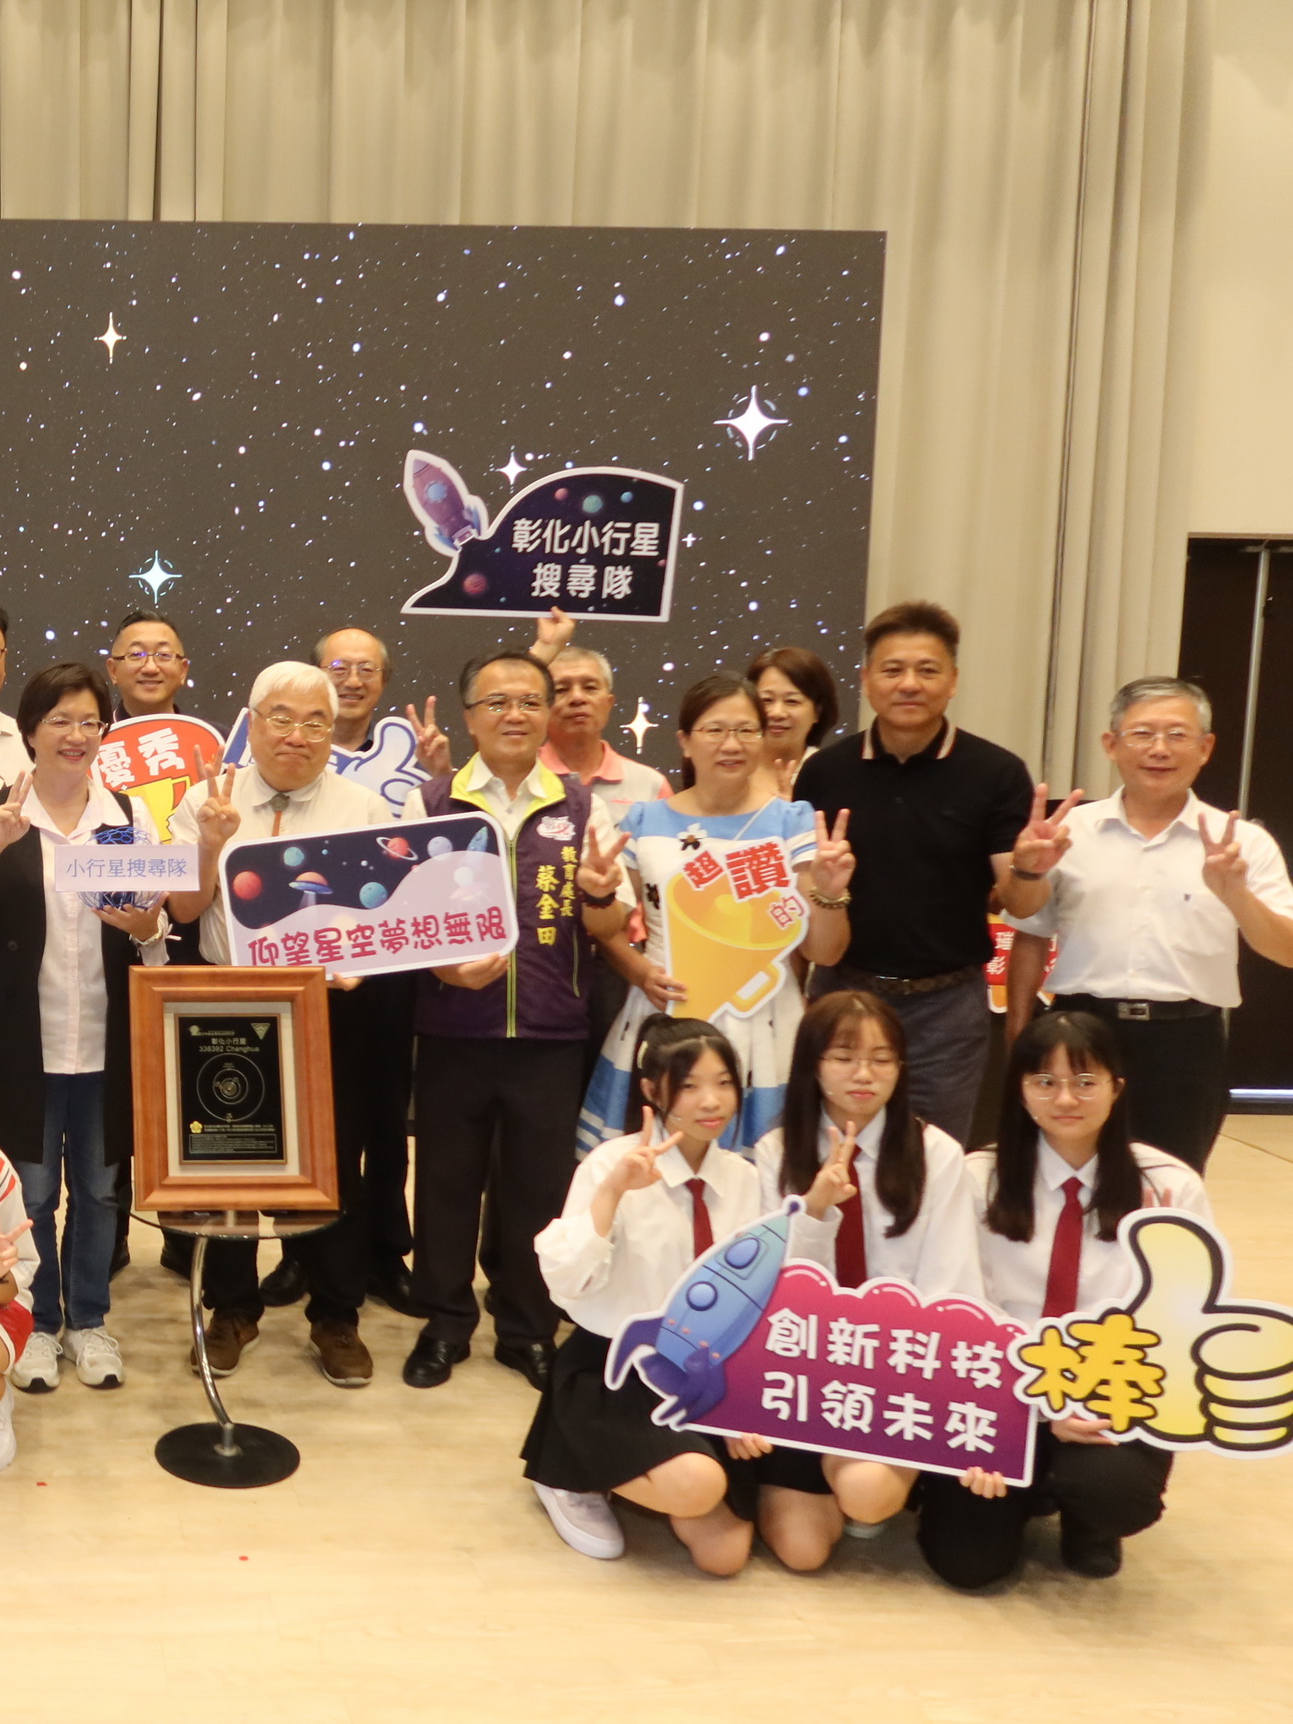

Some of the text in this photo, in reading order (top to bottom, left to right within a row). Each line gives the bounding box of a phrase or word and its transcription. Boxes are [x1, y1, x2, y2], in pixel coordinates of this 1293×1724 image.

[511, 518, 660, 557] 彰化小行星
[531, 563, 633, 599] 搜尋隊
[96, 727, 186, 787] 優秀
[66, 858, 187, 878] 小行星搜尋隊
[559, 846, 578, 917] 教育處長
[683, 842, 804, 928] 超讚的
[248, 906, 507, 966] 仰望星空夢想無限
[764, 1307, 1004, 1390] 創新科技
[1019, 1313, 1166, 1432] 棒
[761, 1370, 998, 1453] 引領未來
